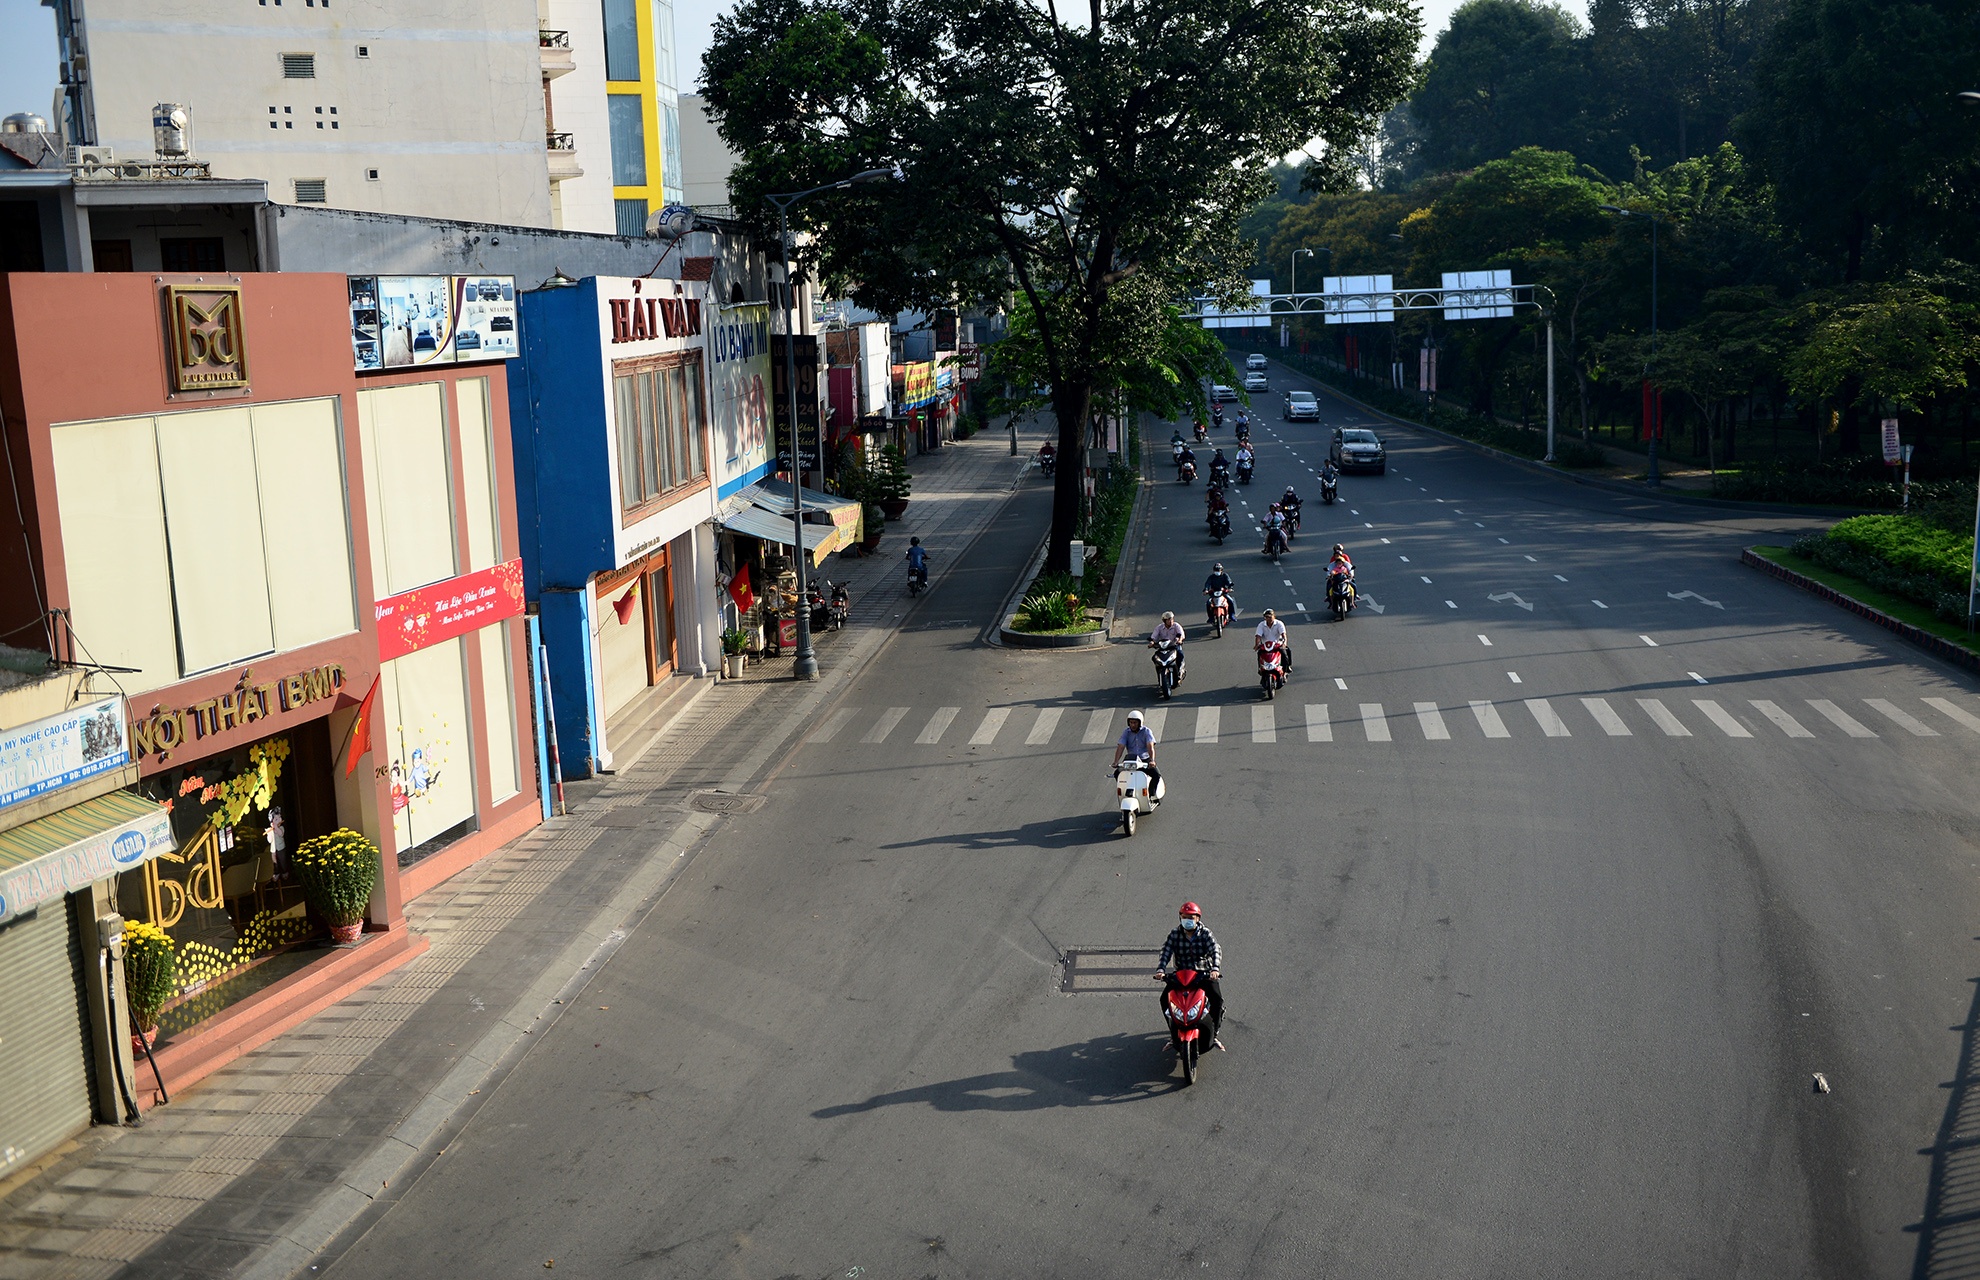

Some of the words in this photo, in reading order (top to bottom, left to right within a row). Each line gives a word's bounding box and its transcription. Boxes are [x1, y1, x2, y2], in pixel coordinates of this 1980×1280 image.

[609, 279, 659, 344] HẢI
[713, 316, 726, 363] LÒ
[729, 314, 754, 361] BÁNH
[756, 312, 768, 356] MÌ
[785, 343, 804, 357] BNH
[184, 371, 238, 383] FURNITURE
[777, 403, 815, 416] 2424
[375, 605, 395, 622] Year
[128, 702, 189, 764] NỘI
[187, 667, 278, 738] THẤT
[278, 662, 347, 712] BMD
[20, 729, 42, 745] NGHỆ
[44, 725, 61, 737] CAO
[62, 717, 78, 732] CẤP
[13, 786, 30, 799] BÌNH
[36, 776, 63, 792] TP.HCM
